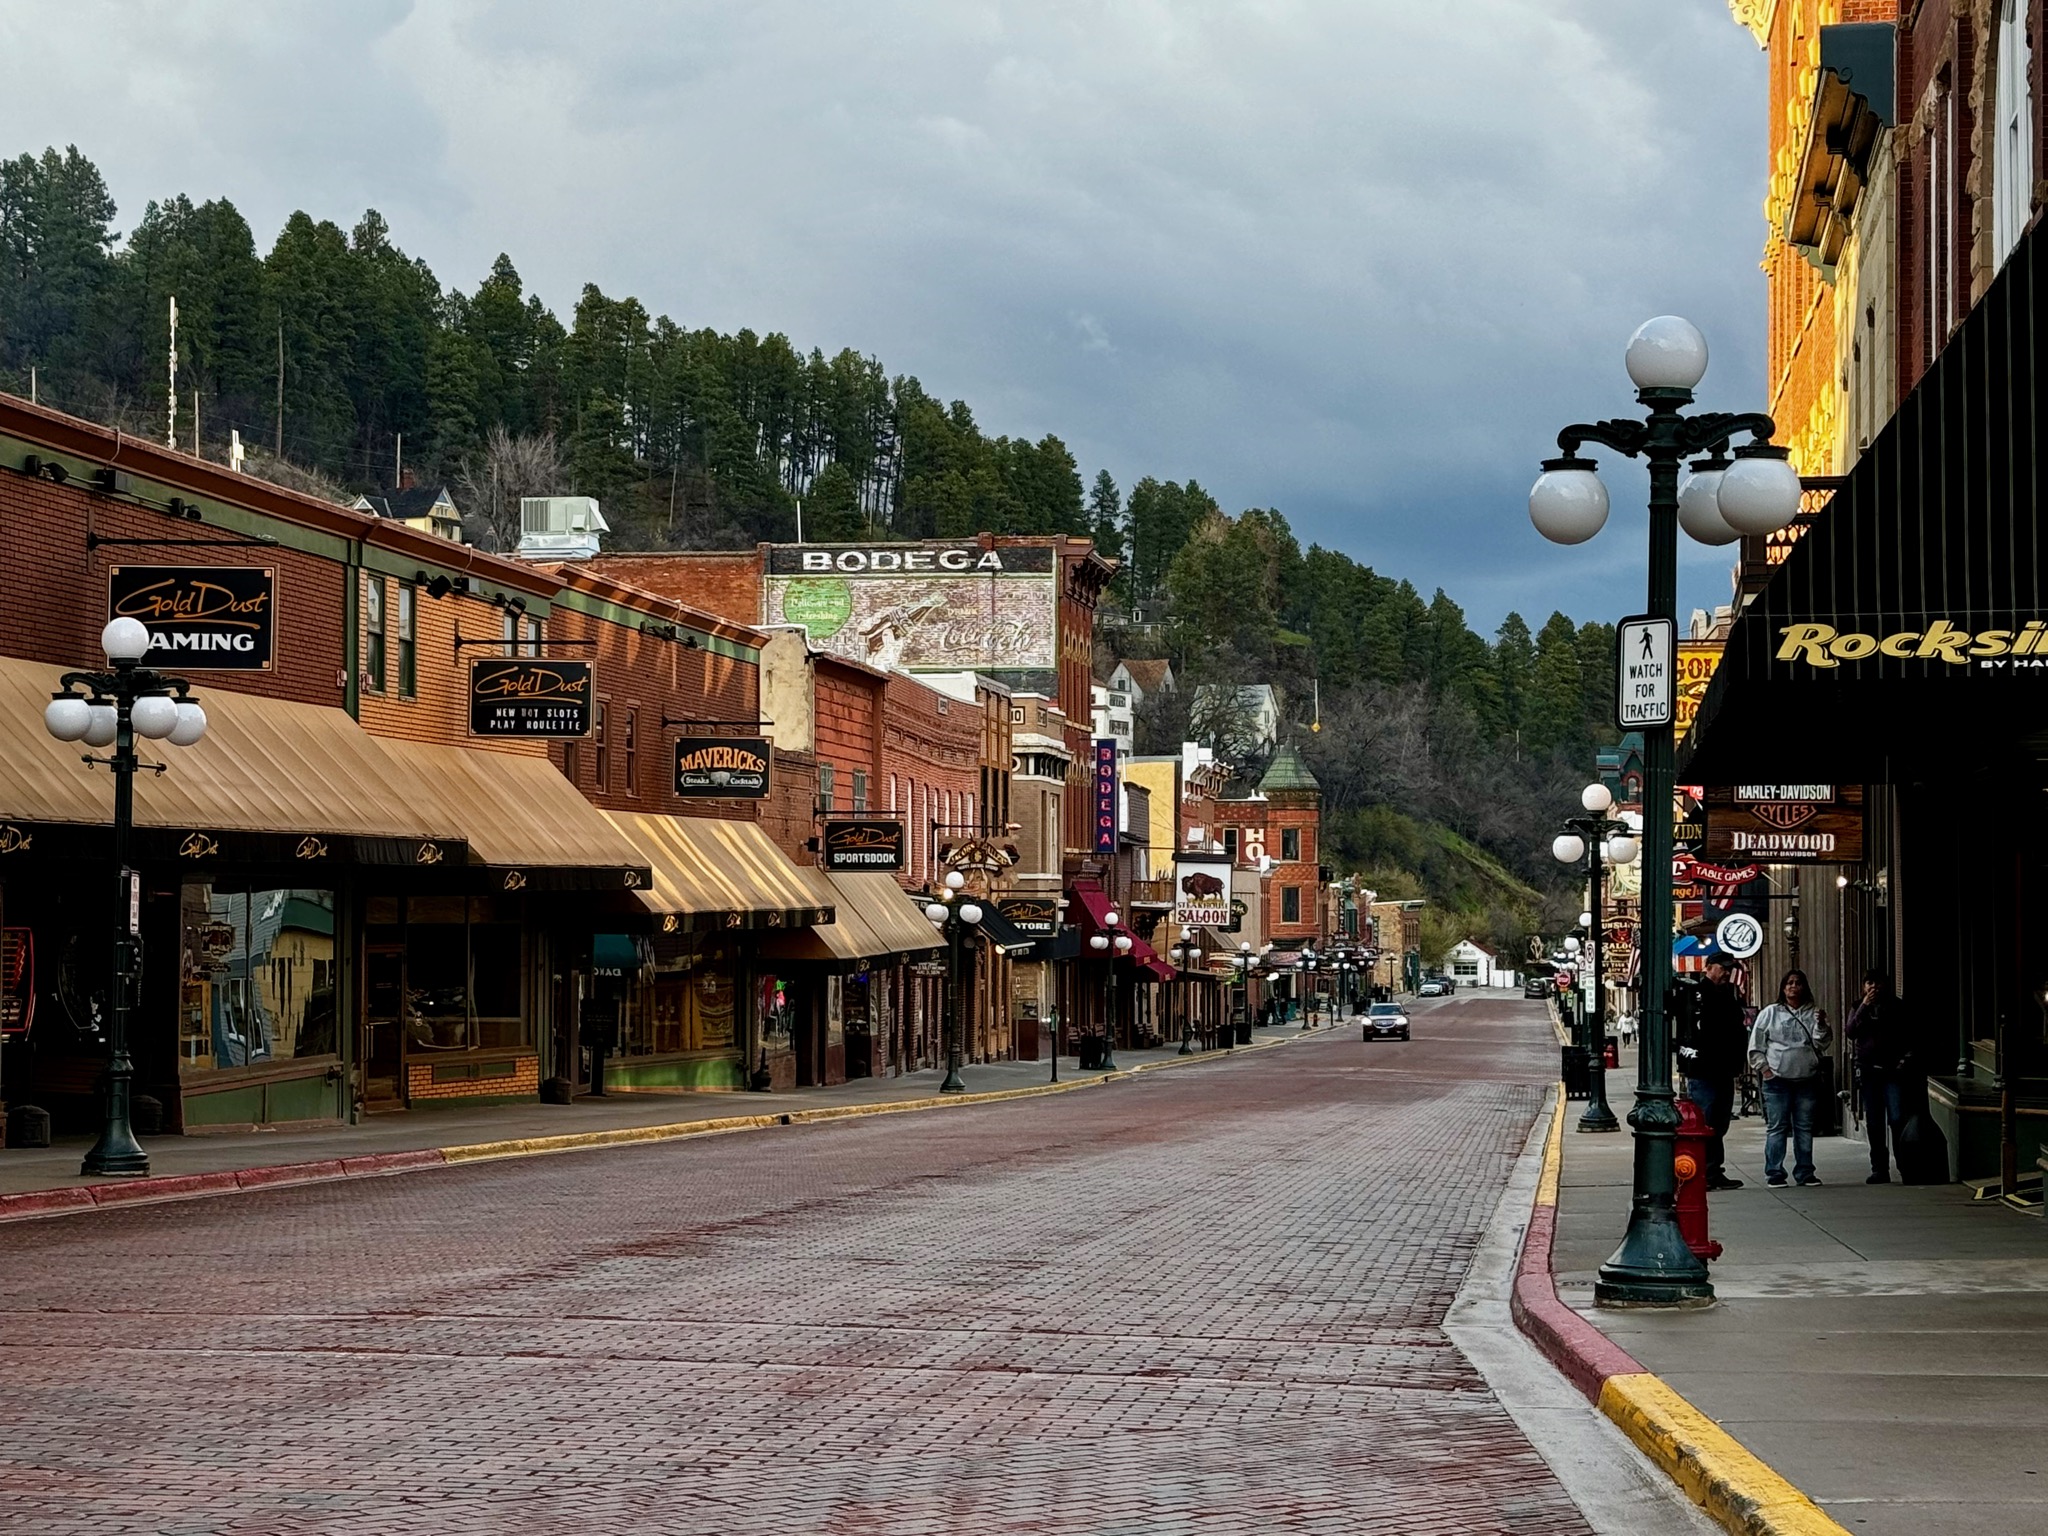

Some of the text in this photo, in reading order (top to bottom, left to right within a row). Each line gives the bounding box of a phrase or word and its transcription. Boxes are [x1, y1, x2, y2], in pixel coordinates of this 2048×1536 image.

[802, 550, 1004, 571] BODEGA
[115, 578, 269, 618] Gold Dust
[147, 632, 255, 652] AMING
[1775, 620, 2048, 668] Rocksi
[1629, 663, 1663, 680] WATCH
[1980, 660, 2005, 668] BY
[475, 665, 589, 696] Gold Dust
[1635, 683, 1655, 698] FOR
[496, 708, 516, 718] NEW
[547, 709, 579, 719] SLOTS
[1625, 702, 1666, 719] TRAFFIC
[490, 720, 580, 731] PLAY ROULETTE
[680, 746, 766, 773] MAVERICKS
[685, 776, 760, 786] Steaks Cocktails
[1100, 748, 1112, 845] BODEGA
[1738, 785, 1831, 800] HARLEY-DAVIDSON
[1760, 804, 1809, 826] CYCLES
[828, 827, 901, 846] Gold Dust
[1732, 831, 1835, 852] DEADWOOD
[1696, 866, 1723, 881] TABLE
[1724, 867, 1755, 882] GAMES
[1177, 909, 1228, 923] SALOON
